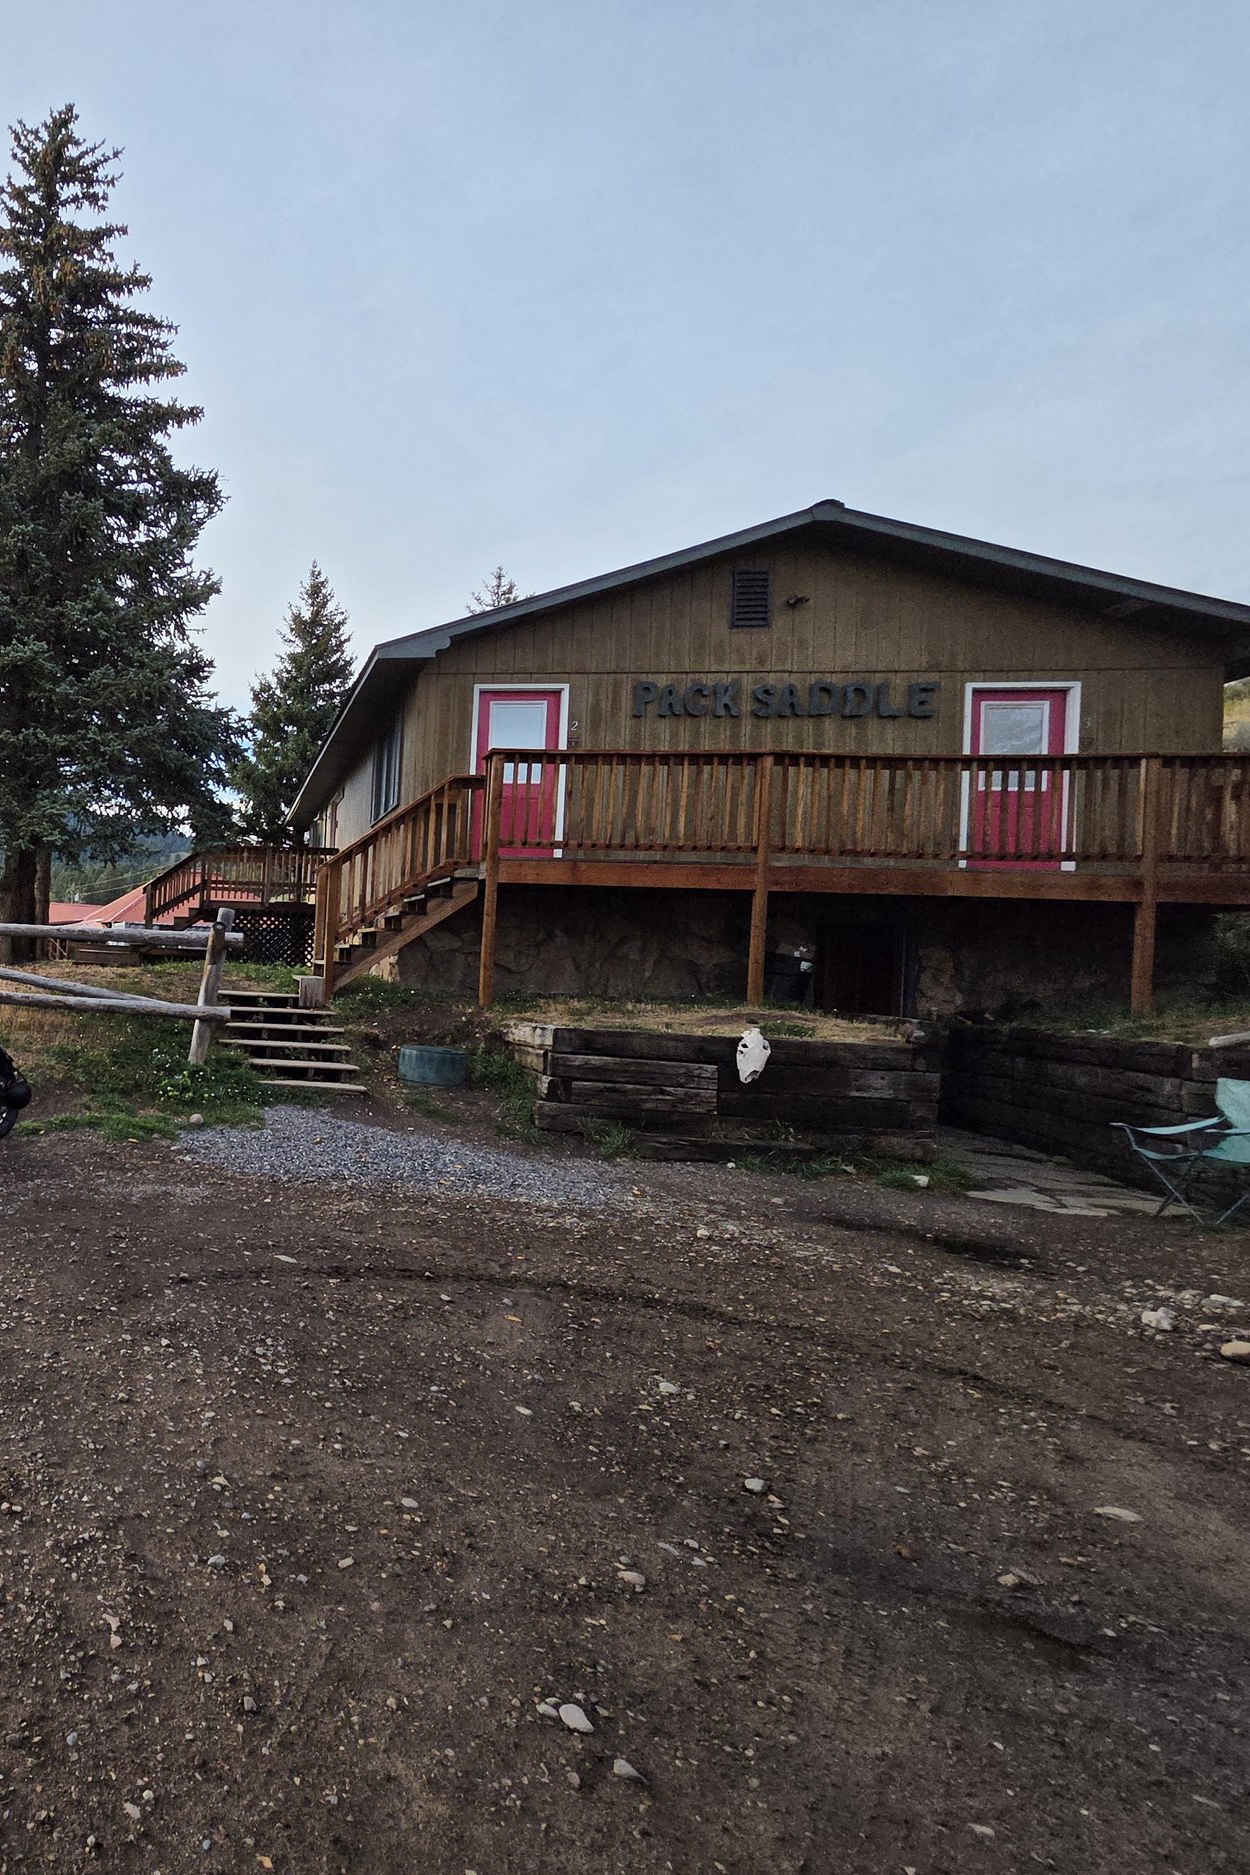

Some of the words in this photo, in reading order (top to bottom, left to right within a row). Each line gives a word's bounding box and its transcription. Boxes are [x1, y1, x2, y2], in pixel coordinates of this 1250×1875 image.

[633, 681, 741, 717] PACK
[752, 682, 940, 718] SADDLE
[571, 720, 579, 731] 2
